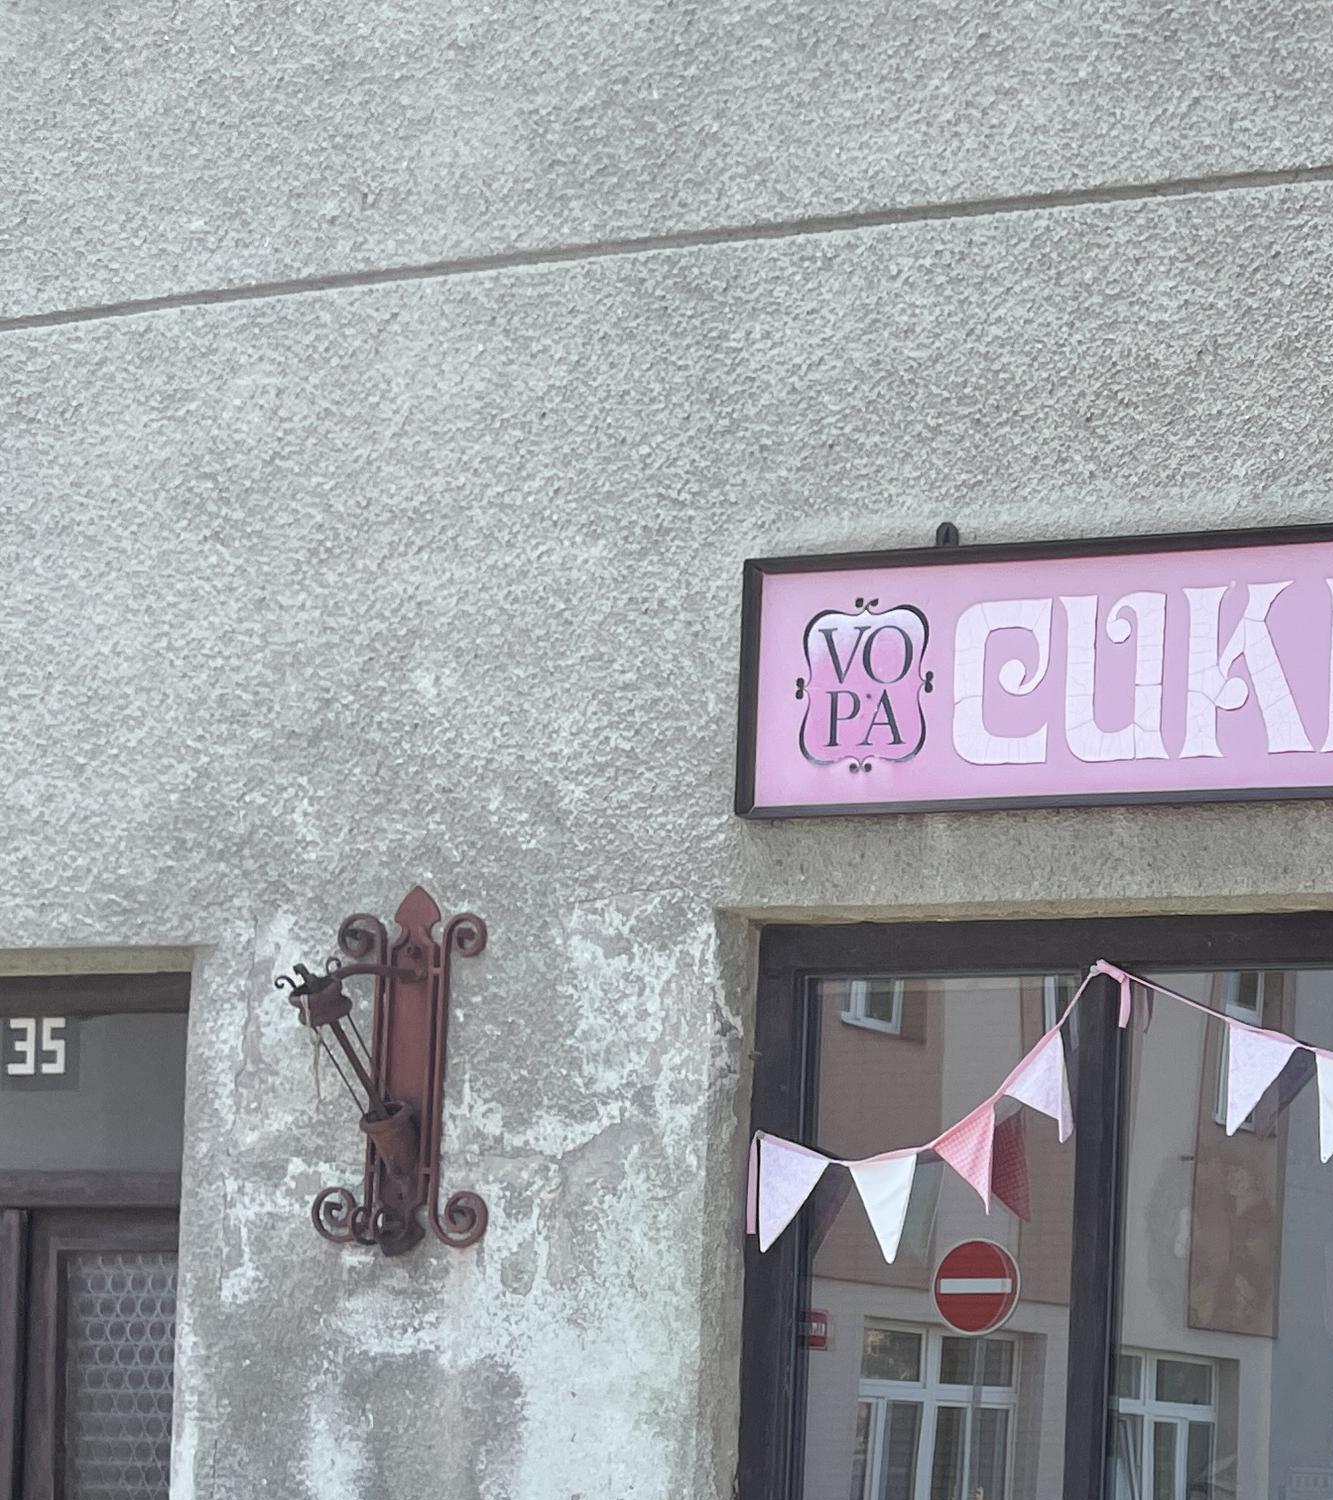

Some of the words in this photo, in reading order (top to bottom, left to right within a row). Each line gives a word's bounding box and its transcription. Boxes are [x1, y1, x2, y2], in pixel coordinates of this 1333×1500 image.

[818, 625, 914, 684] VO
[824, 689, 907, 747] PA
[7, 1017, 66, 1075] 35
